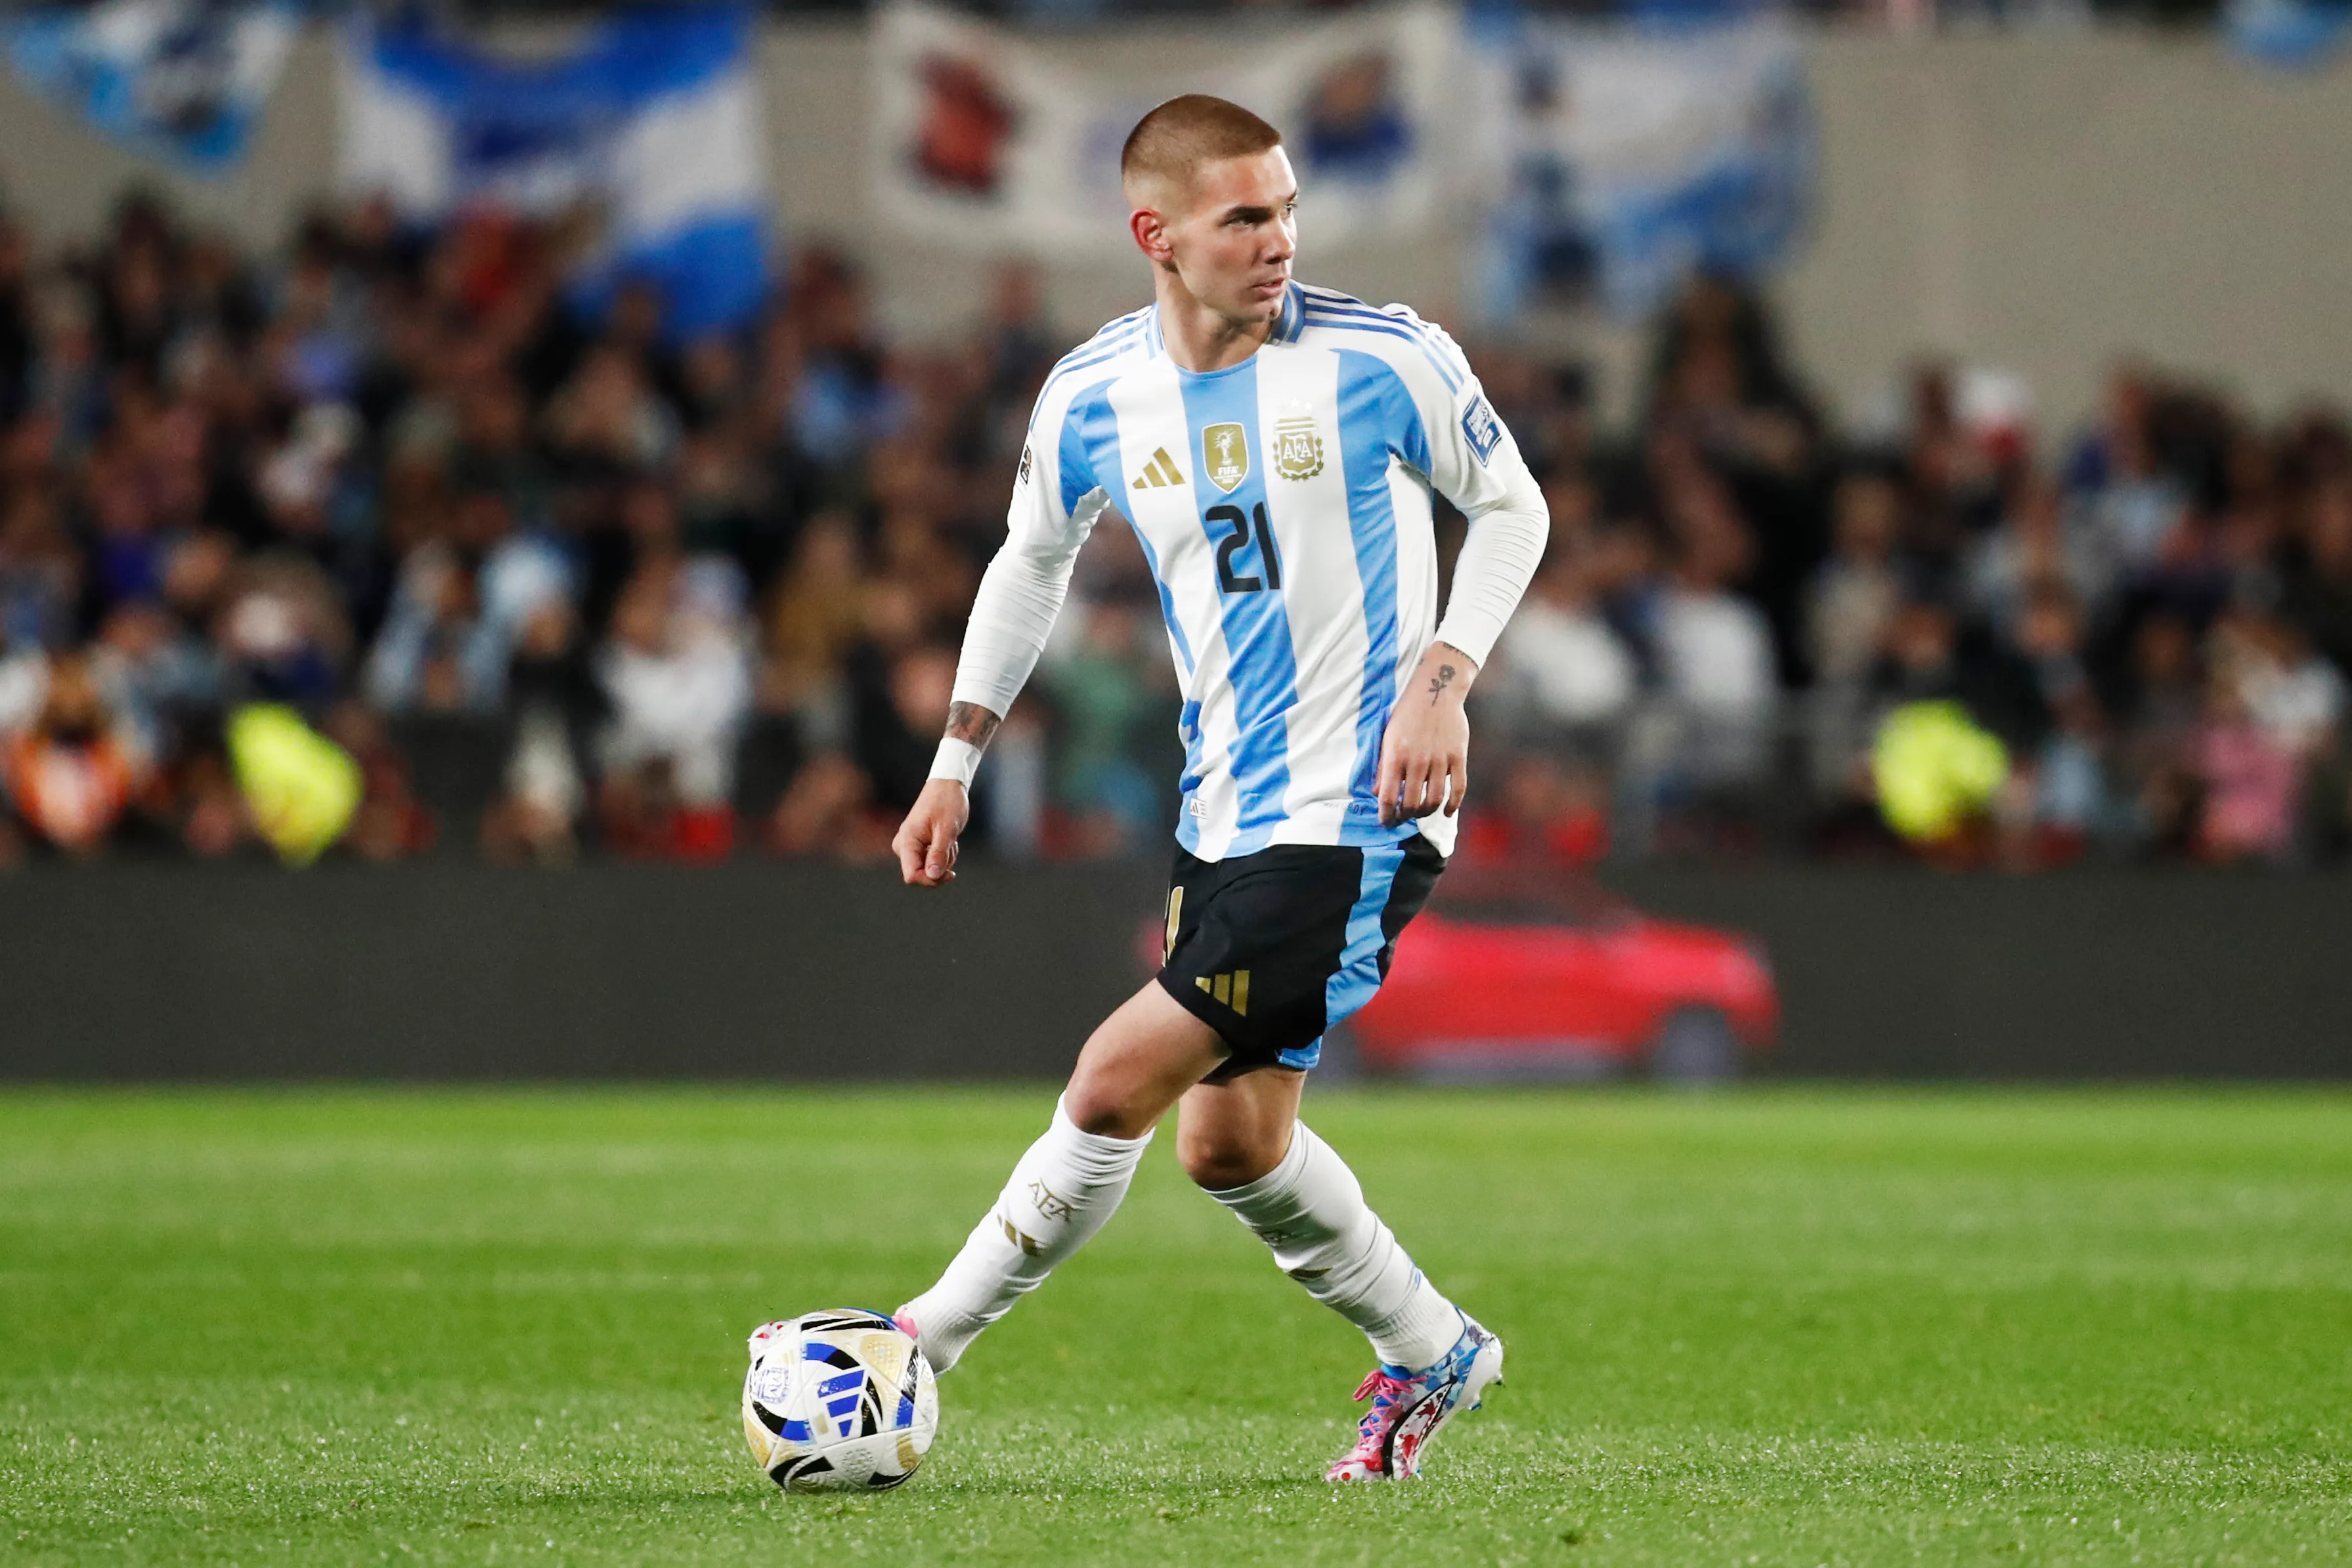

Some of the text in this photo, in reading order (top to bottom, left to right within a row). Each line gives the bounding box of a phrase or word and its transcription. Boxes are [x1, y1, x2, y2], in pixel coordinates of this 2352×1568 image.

[1282, 433, 1313, 463] AFA
[1217, 465, 1239, 475] FIFA
[1206, 501, 1280, 594] 21
[1028, 1176, 1072, 1223] AFA
